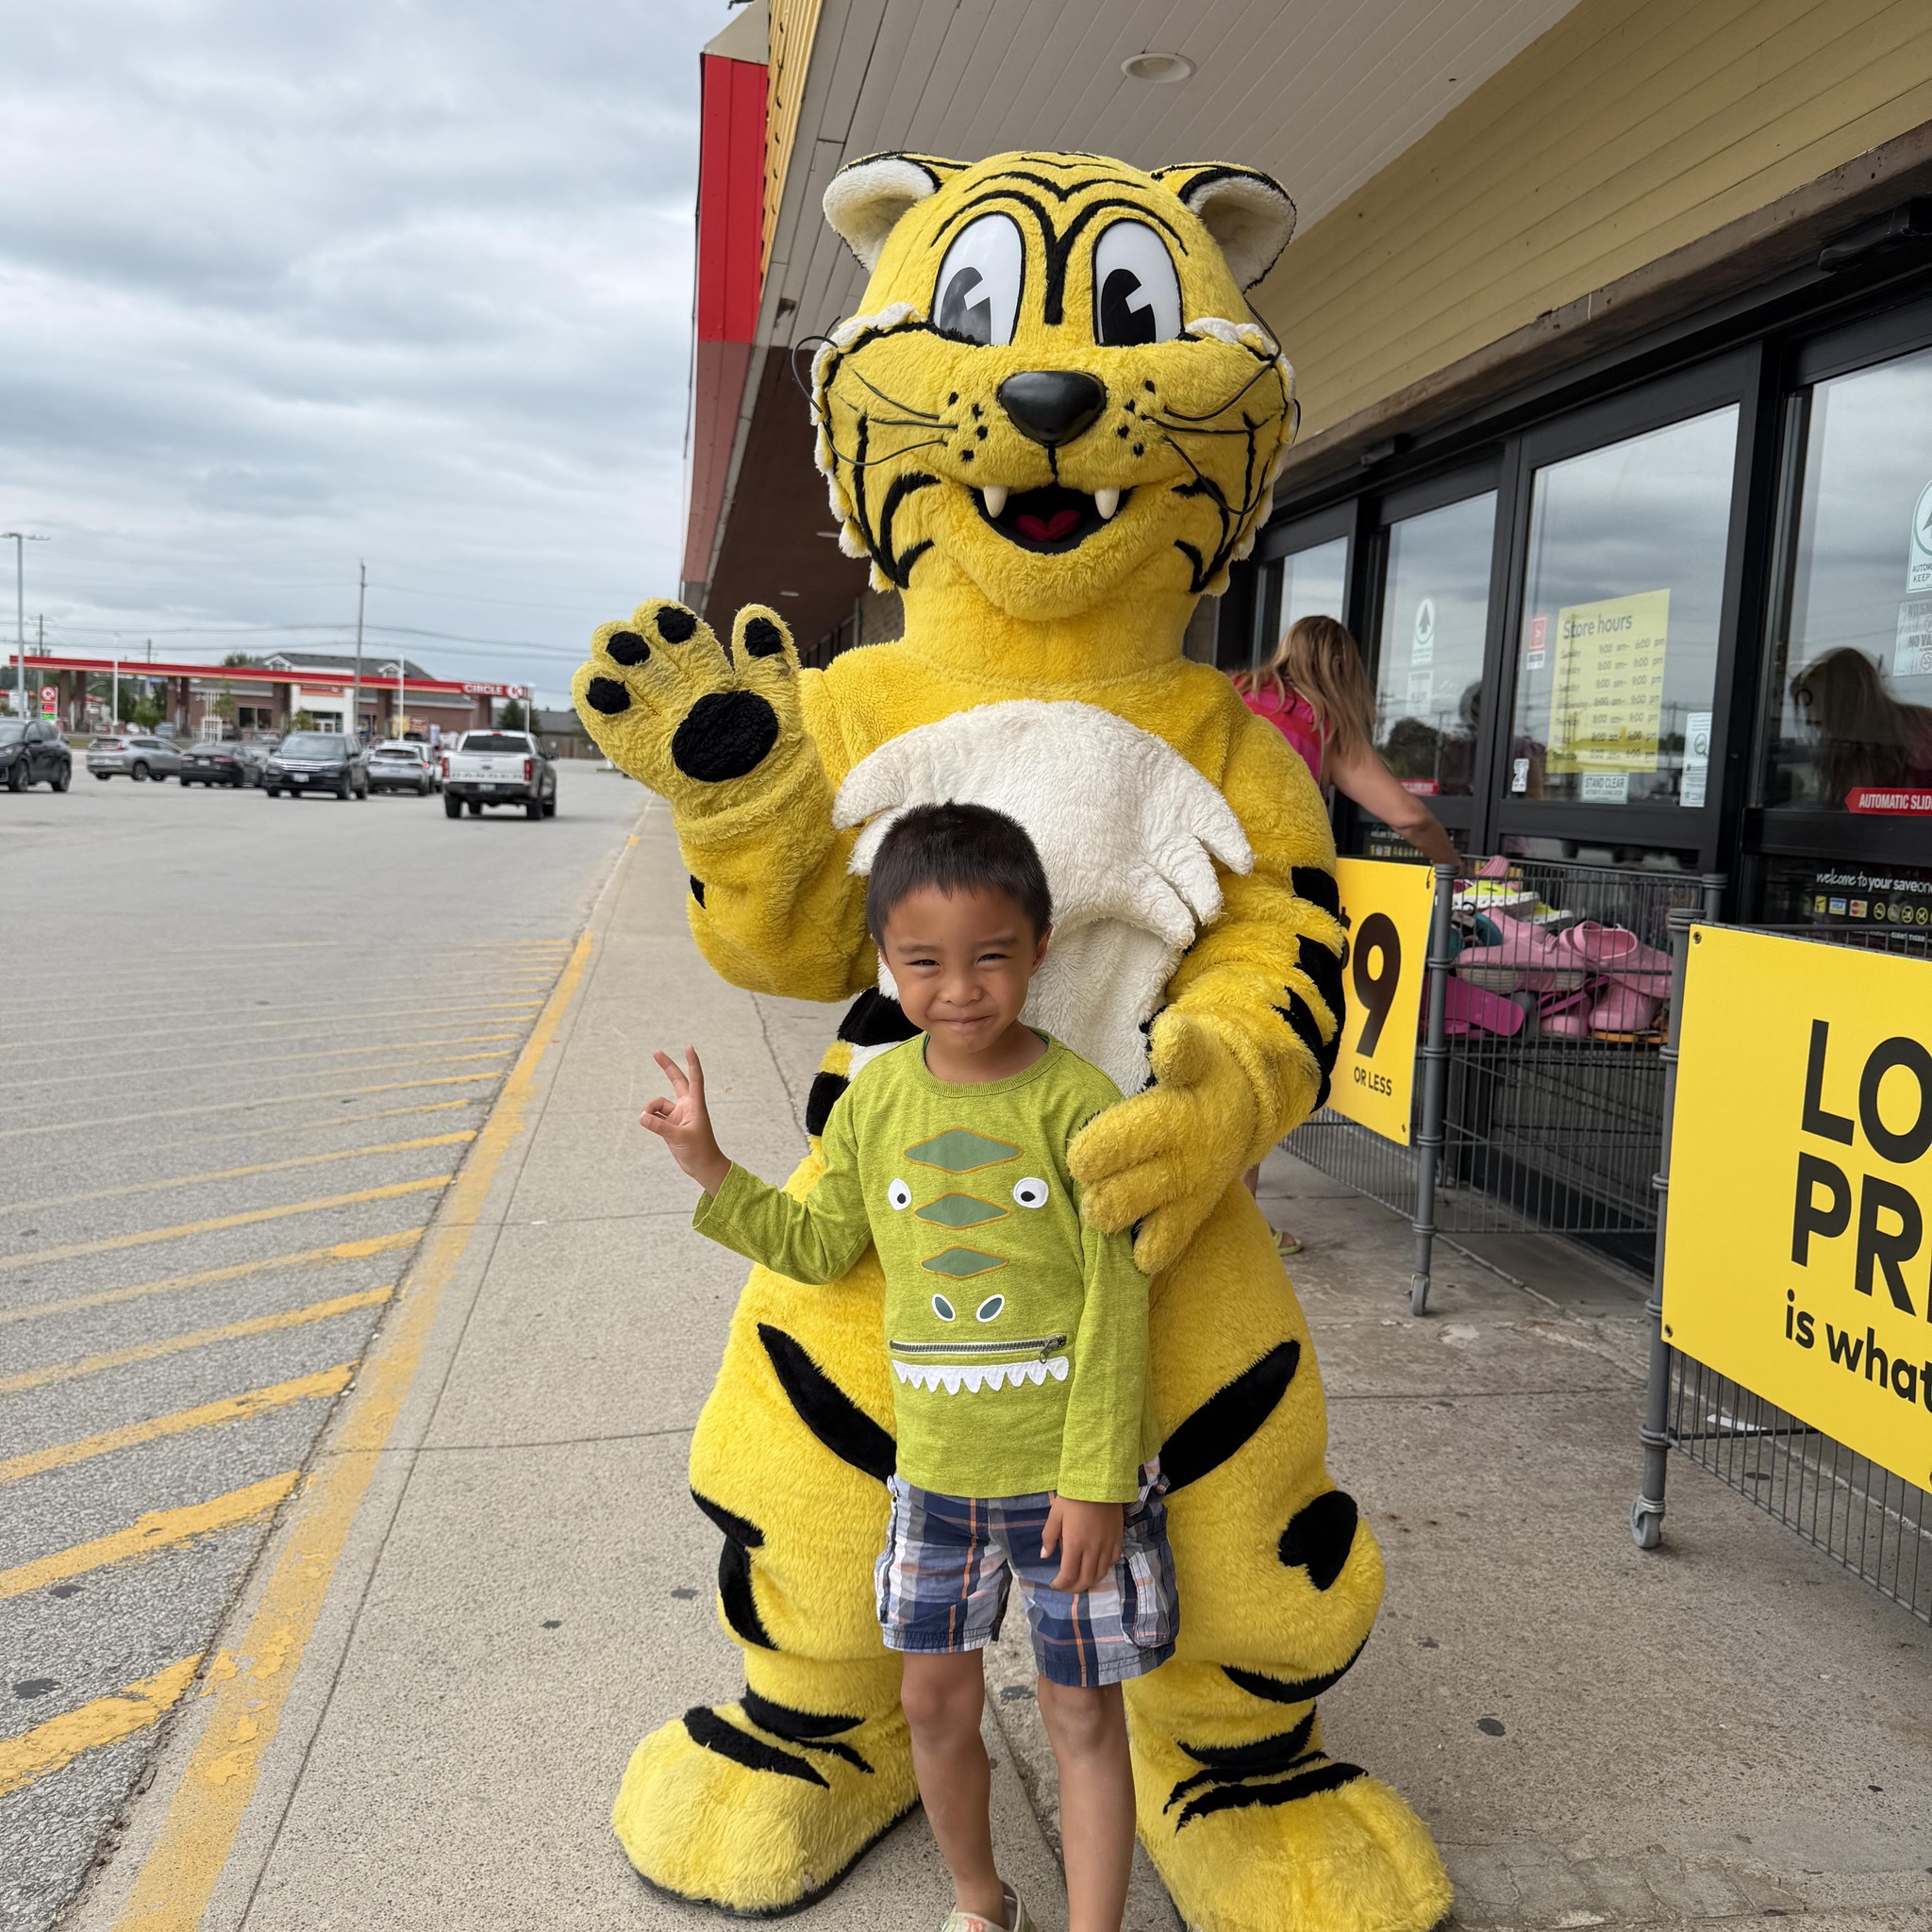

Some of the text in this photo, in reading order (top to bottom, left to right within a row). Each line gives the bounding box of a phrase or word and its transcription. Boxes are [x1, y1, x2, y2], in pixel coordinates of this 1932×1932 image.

[1912, 574, 1931, 582] KEEP
[1562, 613, 1633, 640] Store hours
[464, 683, 504, 695] CIRCLE
[1585, 777, 1624, 790] STAND CLEAR
[1858, 793, 1932, 809] AUTOMATIC SLID
[1816, 868, 1932, 894] welcome to your saveon
[1340, 907, 1401, 1058] 9
[1354, 1066, 1392, 1096] OR LESS
[1791, 1151, 1932, 1324] PR
[1786, 1289, 1932, 1413] is what
